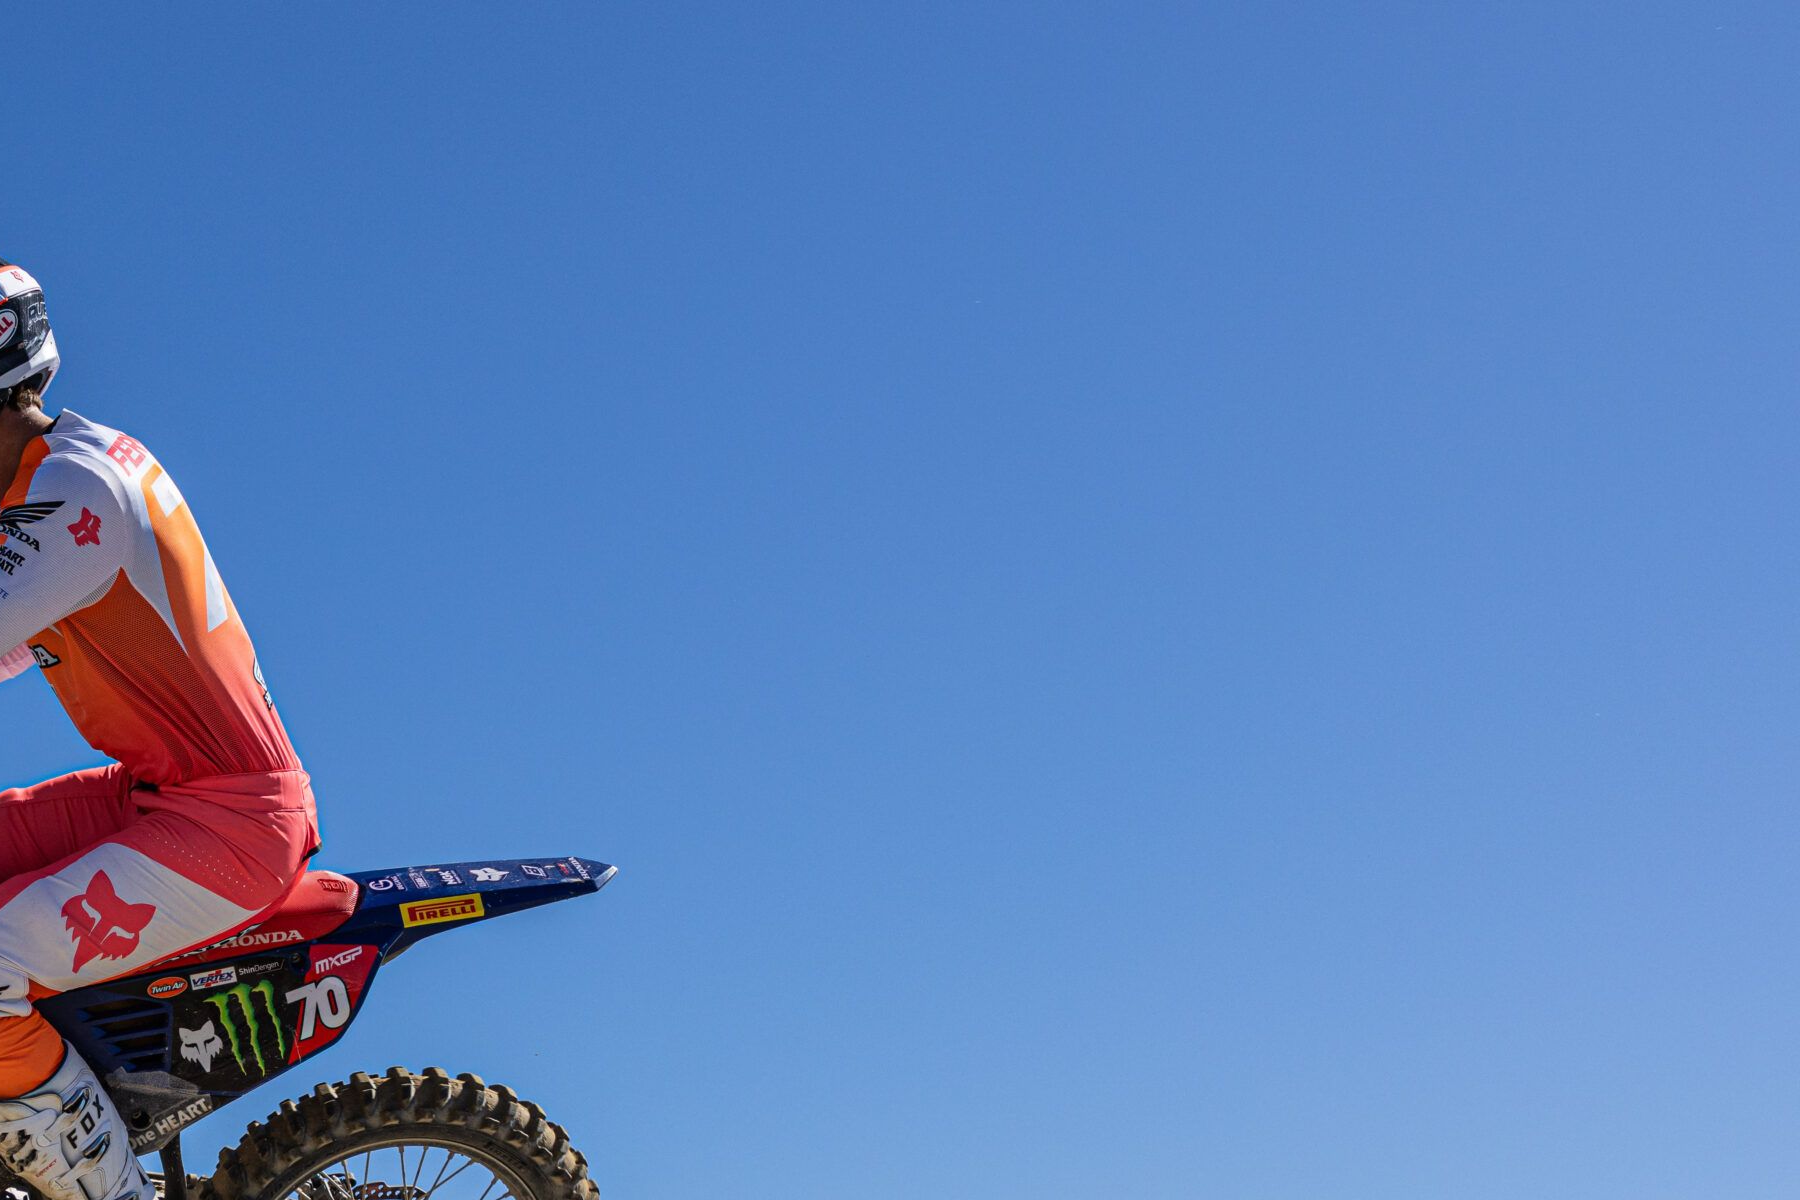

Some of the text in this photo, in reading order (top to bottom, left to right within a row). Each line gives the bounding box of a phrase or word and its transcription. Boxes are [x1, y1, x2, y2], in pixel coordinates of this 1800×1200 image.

[407, 898, 476, 922] PIRELLI
[238, 961, 280, 976] ShinDengen
[315, 946, 362, 974] MXGP
[151, 984, 171, 994] Twin
[172, 981, 184, 991] Air
[192, 970, 234, 987] VERTEX
[285, 975, 351, 1041] 70
[66, 1093, 105, 1150] FOX
[156, 1097, 214, 1136] HEART.
